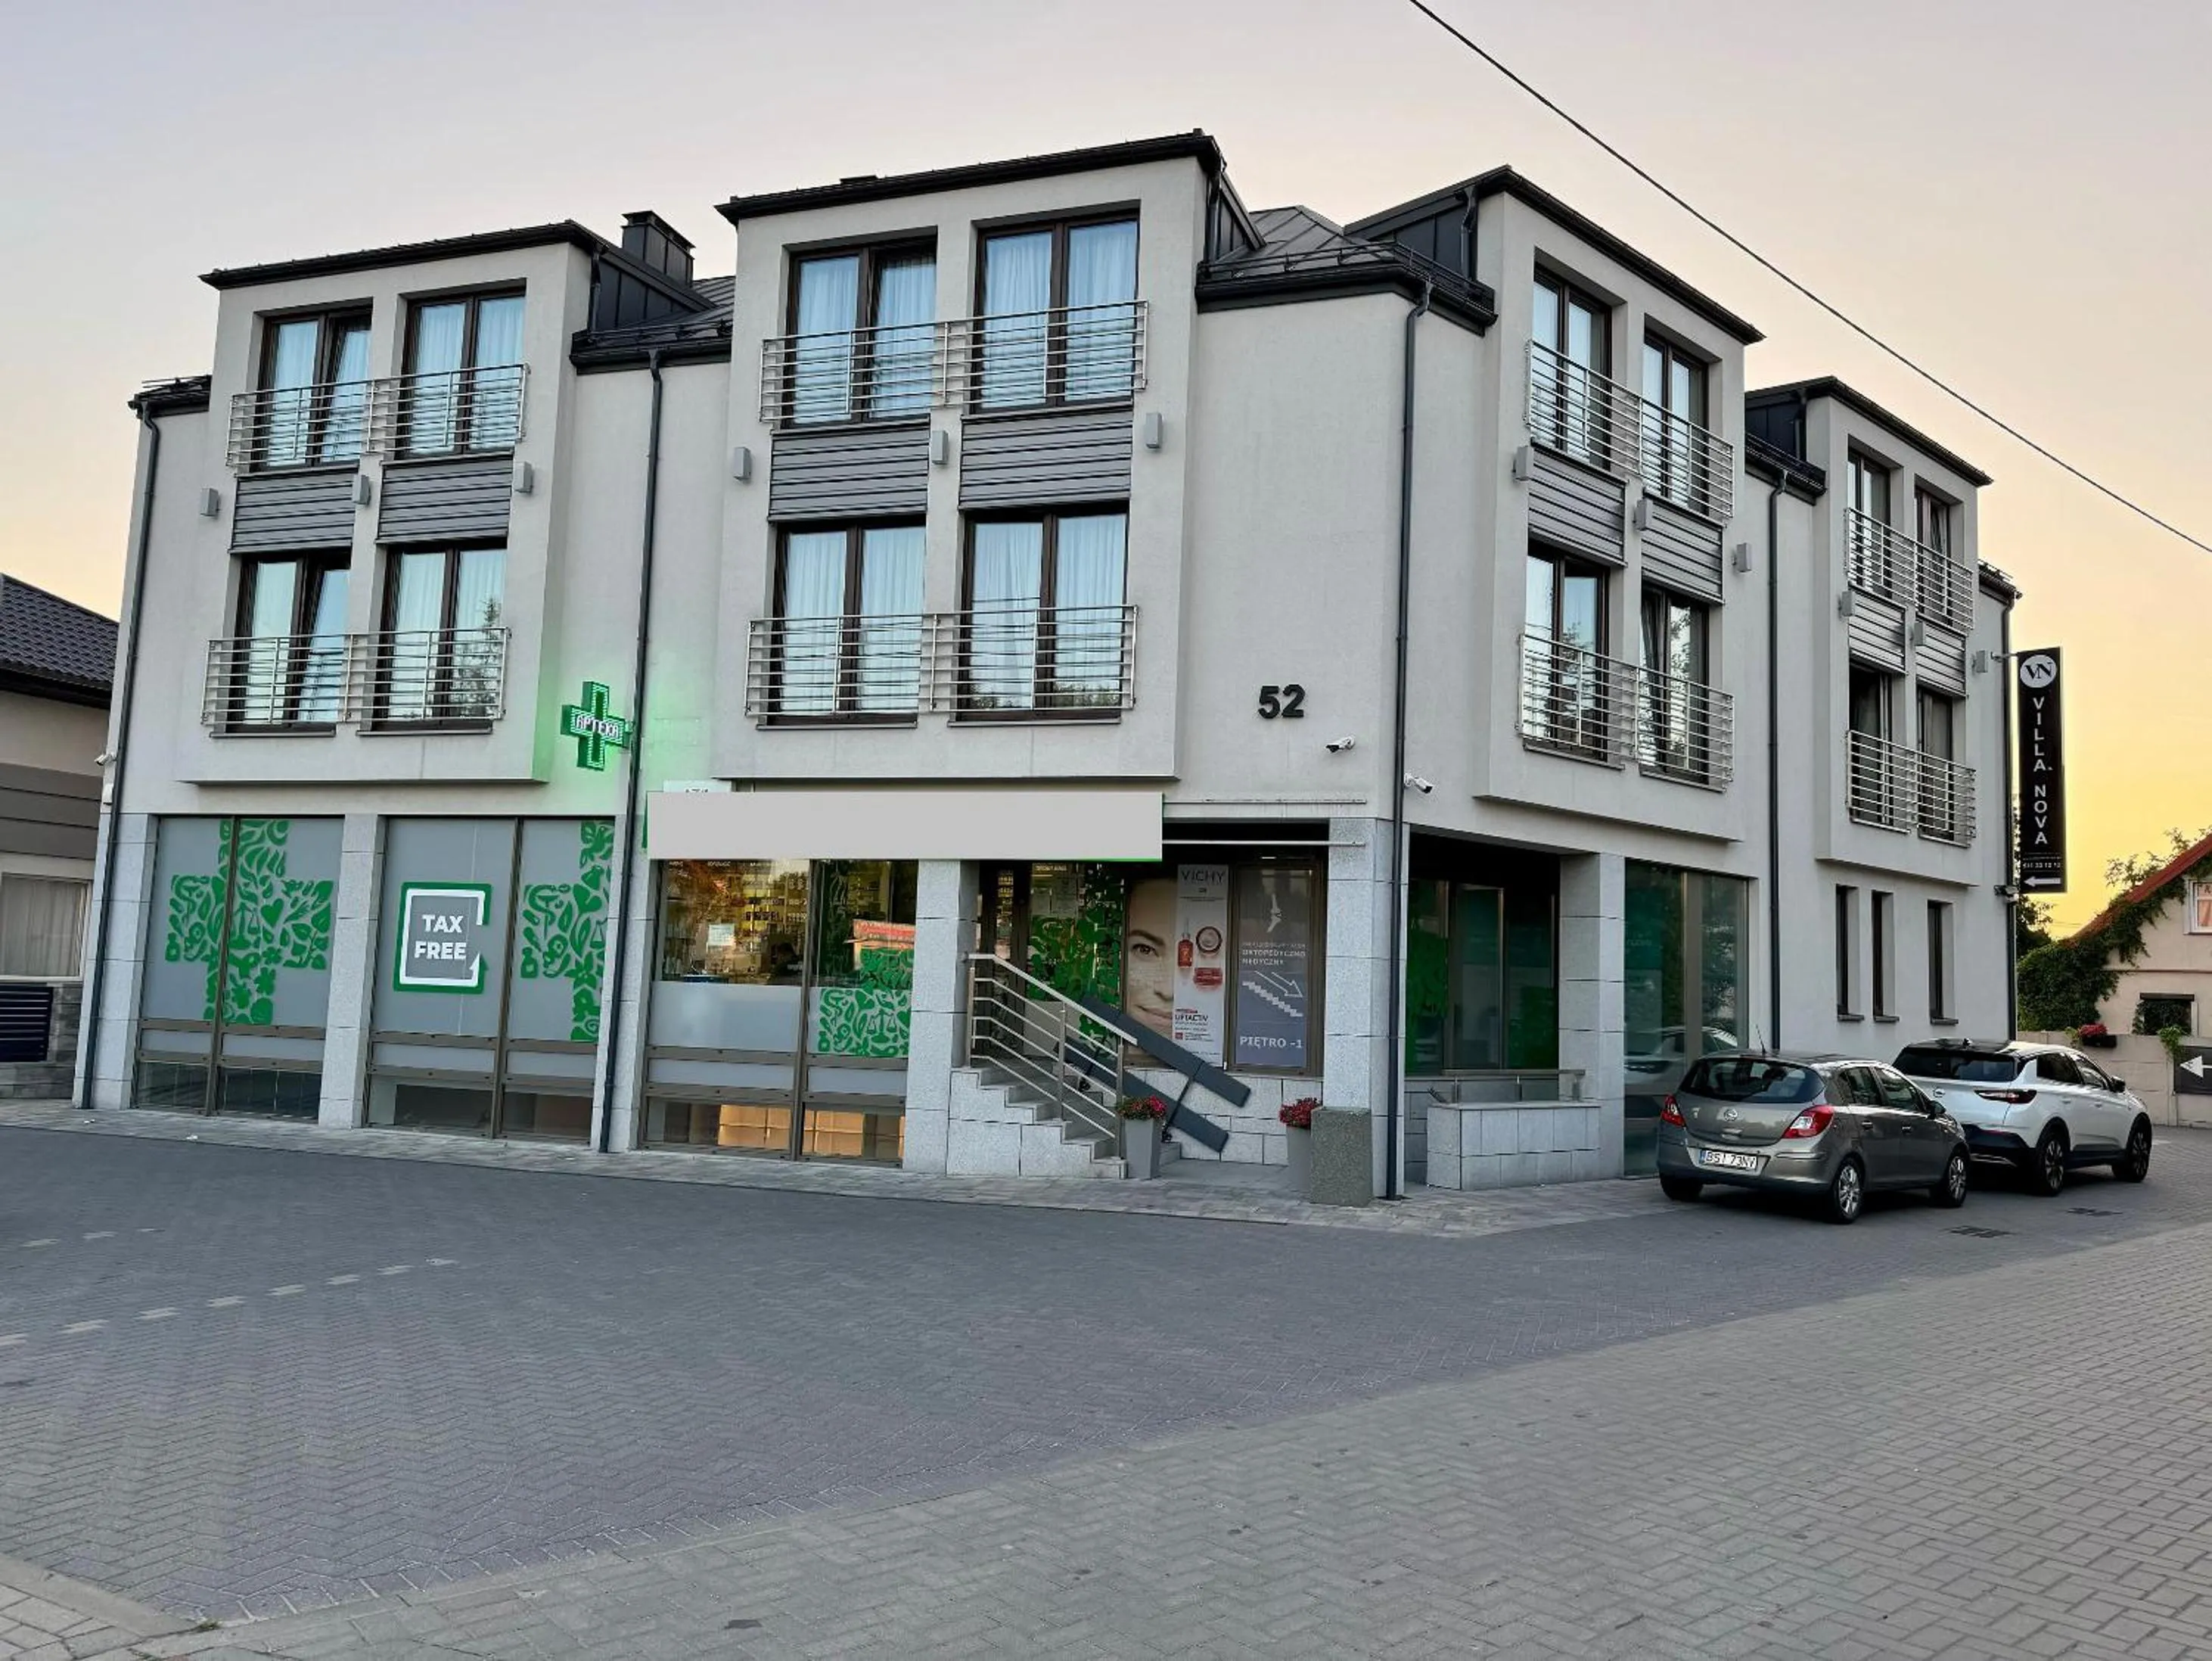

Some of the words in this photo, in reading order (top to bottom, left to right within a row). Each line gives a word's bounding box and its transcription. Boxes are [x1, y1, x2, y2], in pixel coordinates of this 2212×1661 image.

[1258, 684, 1306, 719] 52
[576, 714, 620, 739] APTEKA
[2033, 696, 2046, 772] VILLA
[2033, 784, 2048, 844] NOVA
[1181, 869, 1226, 883] VICHY
[422, 913, 464, 933] TAX
[414, 940, 467, 960] FREE
[1240, 1036, 1287, 1050] PIĘTRO
